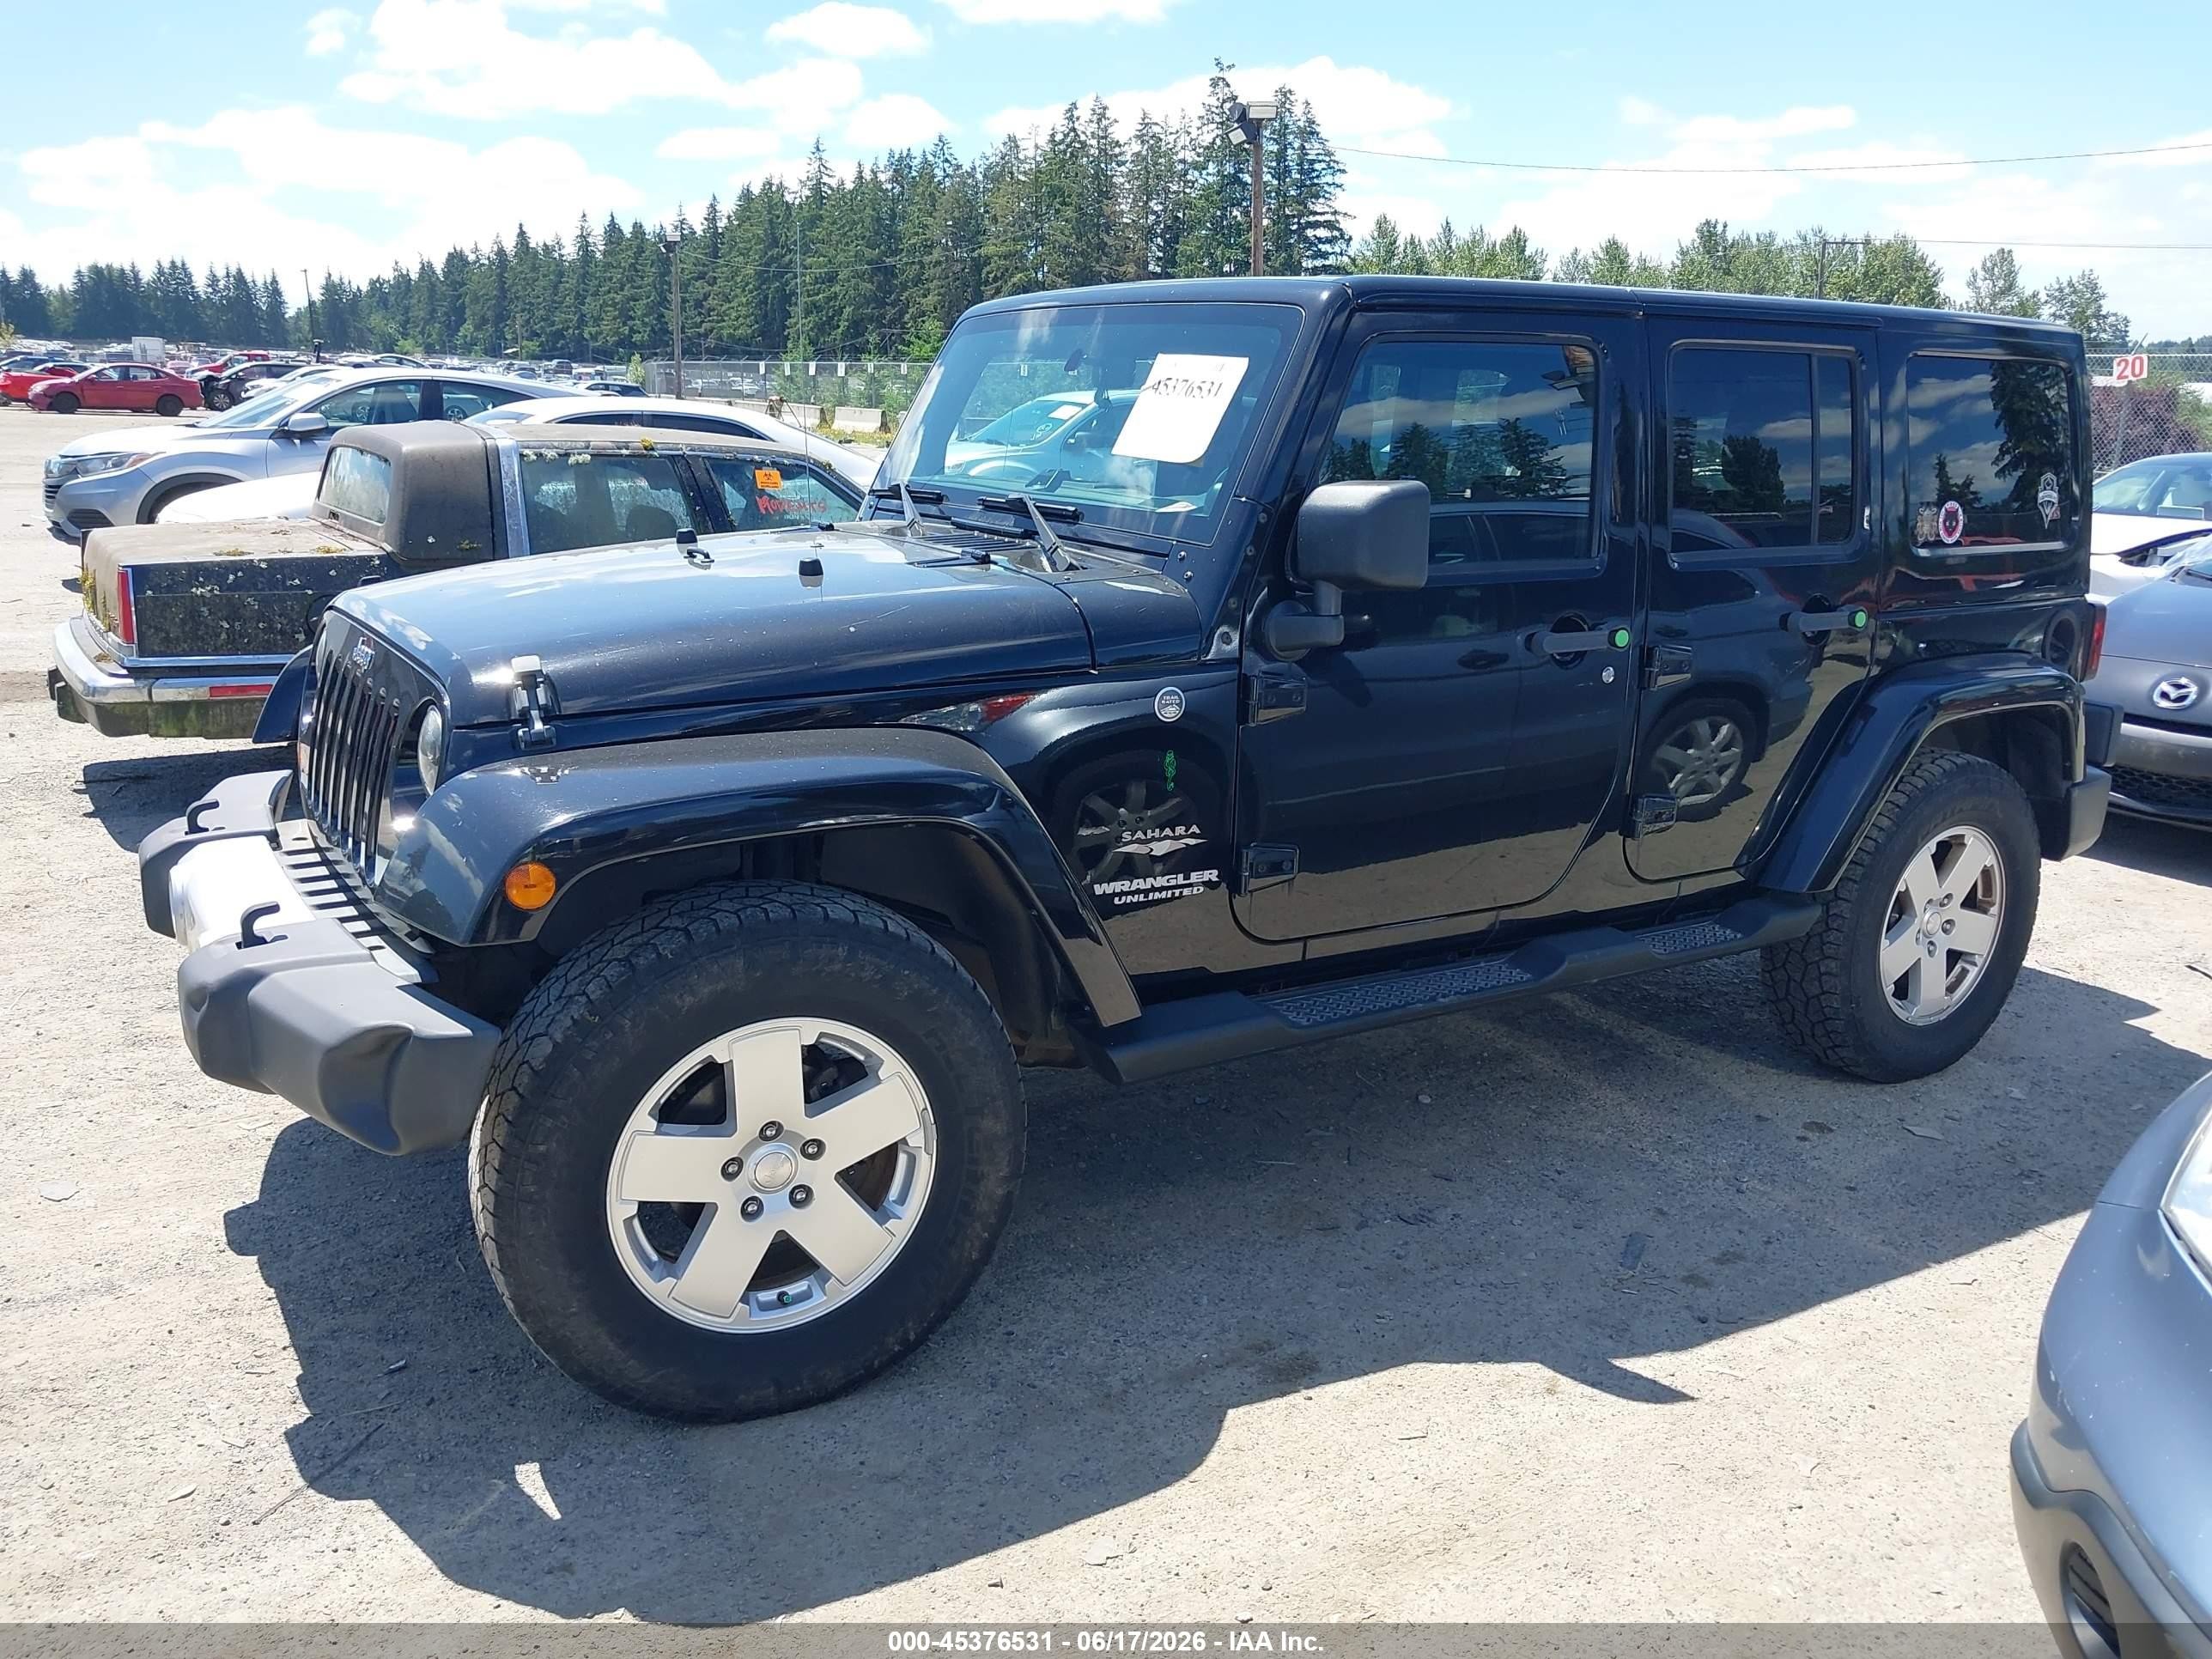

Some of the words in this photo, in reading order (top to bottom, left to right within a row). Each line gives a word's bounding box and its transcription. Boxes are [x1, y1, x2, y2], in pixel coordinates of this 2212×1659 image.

[2116, 356, 2144, 380] 20
[1152, 376, 1224, 399] 45376531
[1121, 823, 1201, 842] SAHARA
[1093, 868, 1220, 896] WRANGLER
[1113, 885, 1205, 905] UNLIMITED
